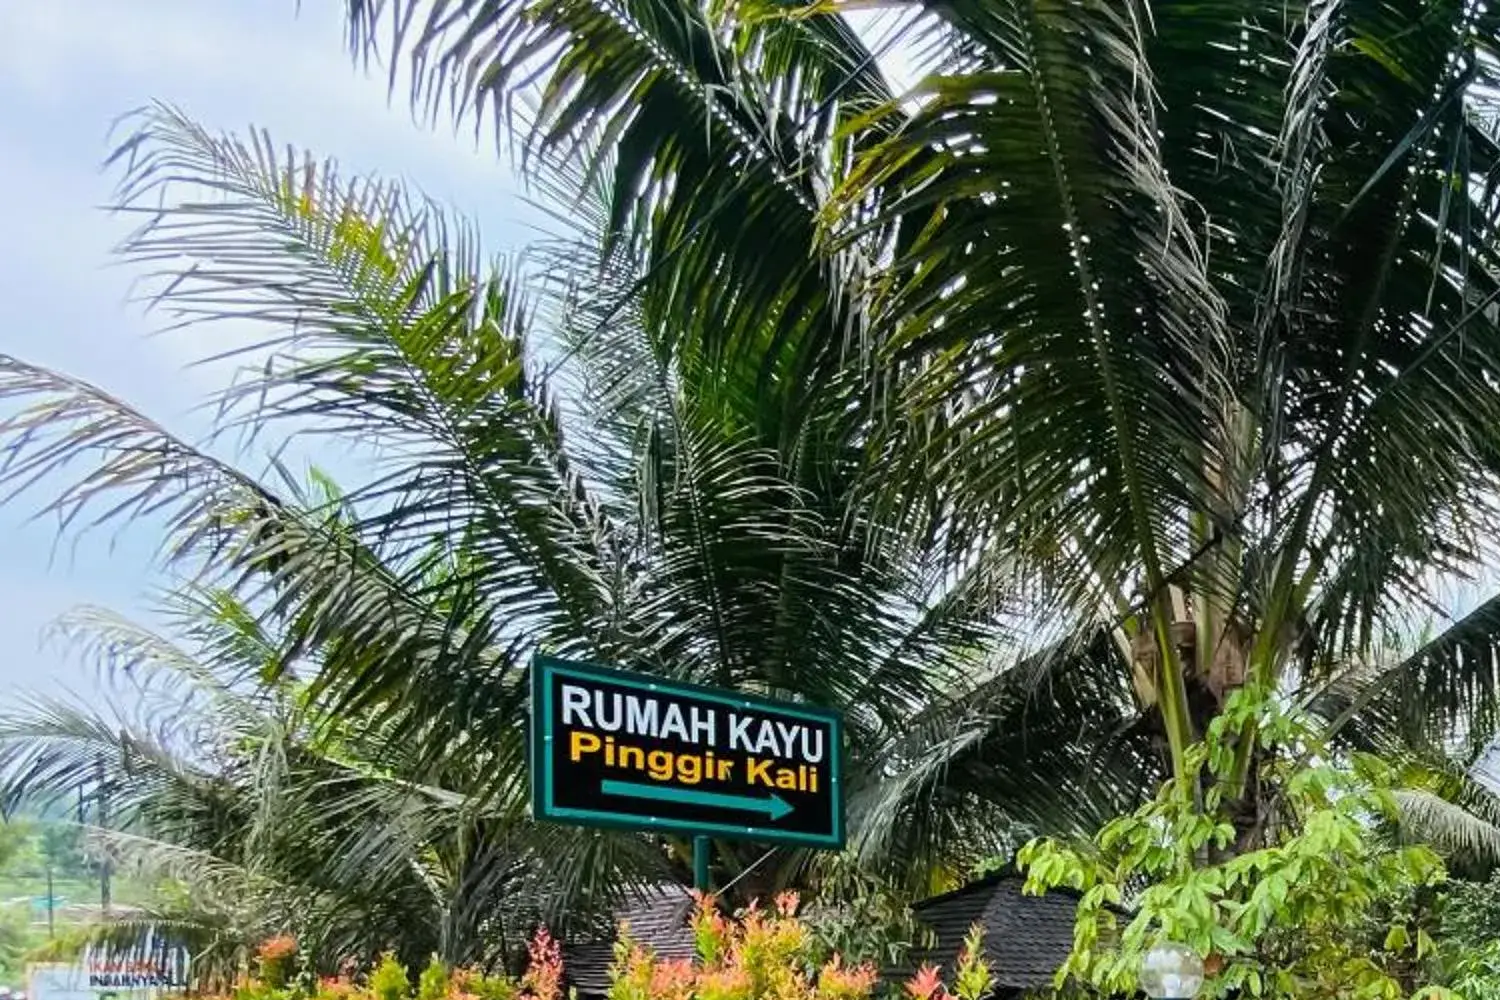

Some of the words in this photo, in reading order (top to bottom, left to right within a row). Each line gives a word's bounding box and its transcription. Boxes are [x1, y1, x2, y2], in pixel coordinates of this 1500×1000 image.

[561, 684, 716, 746] RUMAH
[728, 713, 824, 763] KAYU
[569, 731, 735, 784] Pinggir
[746, 757, 818, 793] Kali
